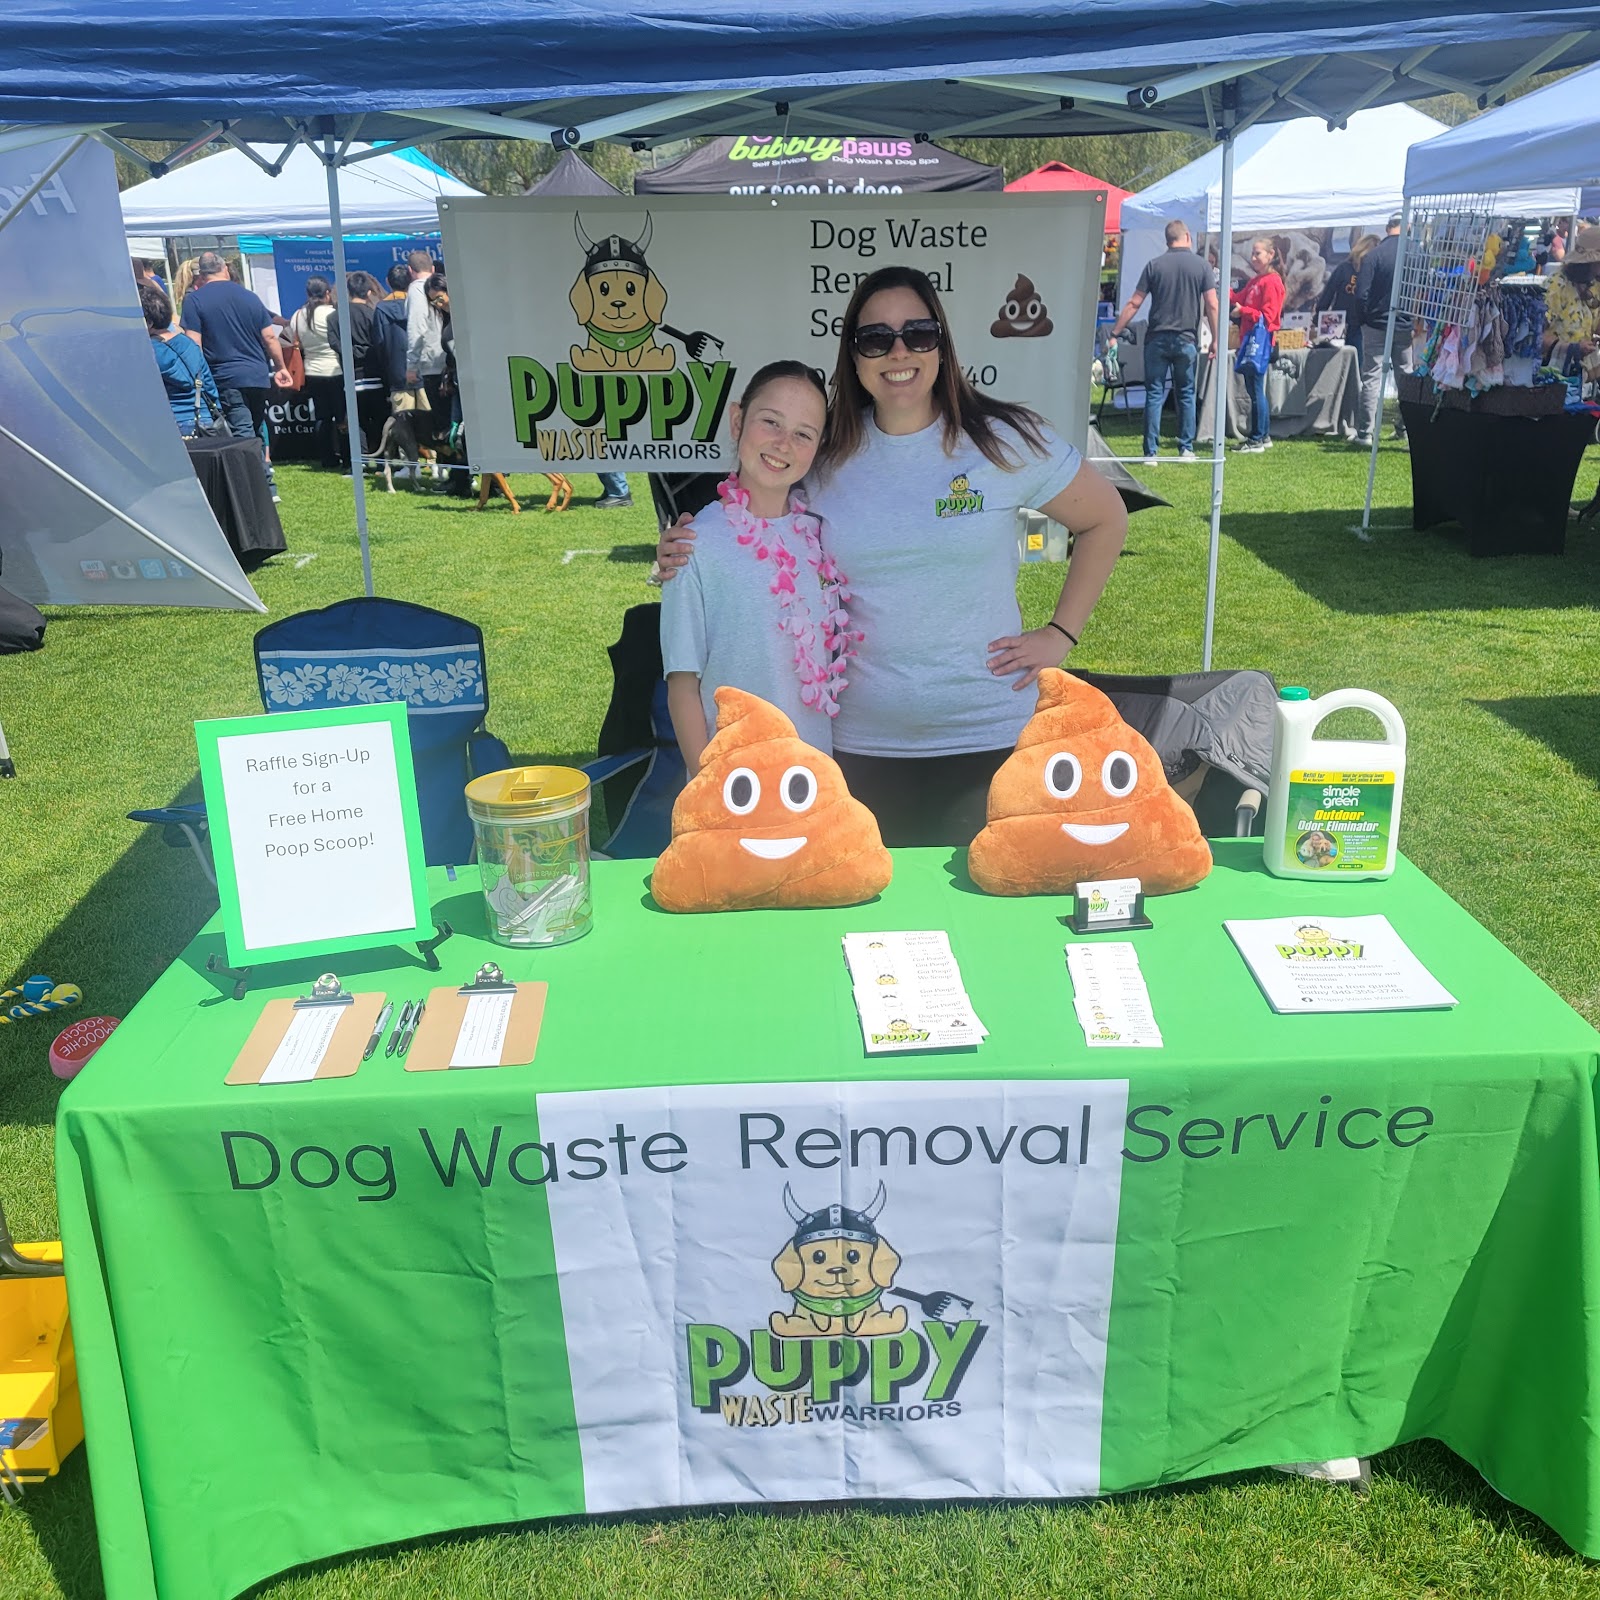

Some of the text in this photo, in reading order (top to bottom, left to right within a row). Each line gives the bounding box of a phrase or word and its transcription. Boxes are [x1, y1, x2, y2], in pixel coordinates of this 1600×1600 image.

[728, 136, 912, 161] bubbly paws
[771, 157, 807, 166] Service
[831, 156, 853, 165] Dog
[895, 158, 916, 166] Dog
[810, 218, 988, 257] Dog Waste
[293, 264, 313, 272] (949)
[810, 262, 954, 294] Real
[507, 355, 737, 449] PUPPY
[274, 424, 314, 434] Pet Car
[536, 428, 721, 461] WASTE WARRIORS
[935, 495, 984, 517] PUPPY
[246, 748, 370, 773] Raffle Sign-Up
[292, 780, 332, 795] for a
[1322, 785, 1361, 798] simple
[1323, 797, 1359, 808] green
[268, 806, 364, 828] Free Home
[1297, 820, 1379, 832] Odor Eliminator
[1314, 810, 1365, 820] Outdoor
[265, 832, 374, 858] Poop Scoop!
[1275, 943, 1365, 960] PUPPY
[871, 1032, 931, 1044] PUPPY
[220, 1095, 1435, 1202] Dog Waste Removal Service
[686, 1319, 990, 1414] PUPPY
[719, 1392, 962, 1427] WASTE WARRIORS
